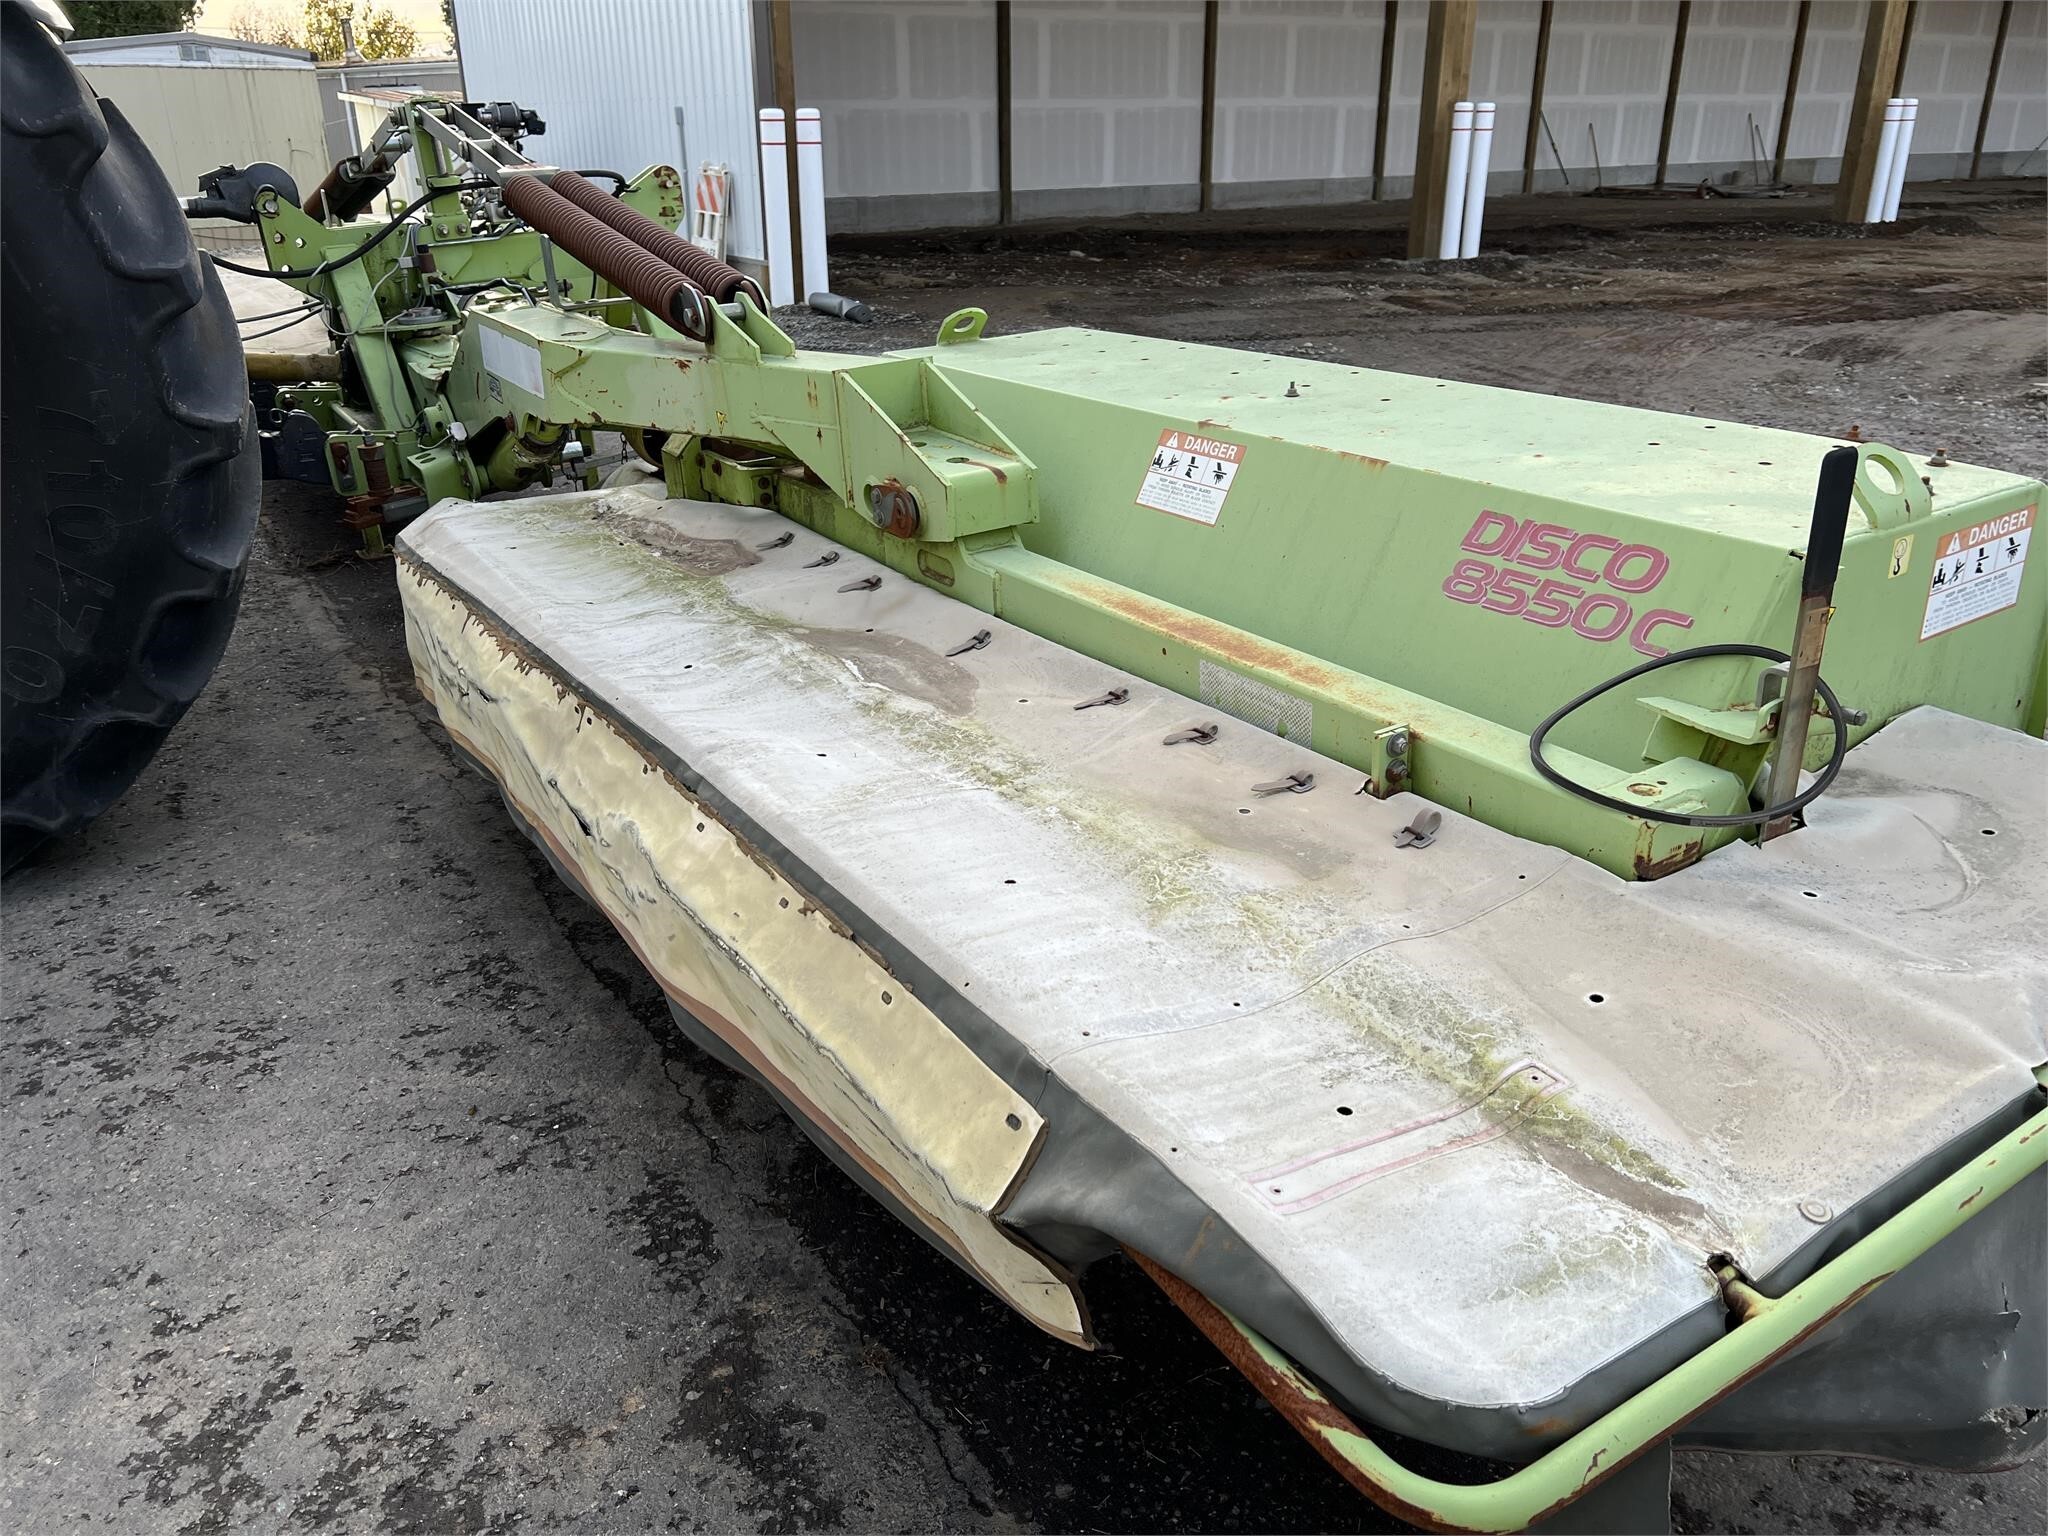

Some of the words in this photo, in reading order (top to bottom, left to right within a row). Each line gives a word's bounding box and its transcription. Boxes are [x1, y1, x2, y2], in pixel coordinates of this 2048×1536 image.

[1184, 436, 1238, 460] DANGER
[1968, 510, 2029, 546] DANGER
[1460, 508, 1670, 594] DISCO
